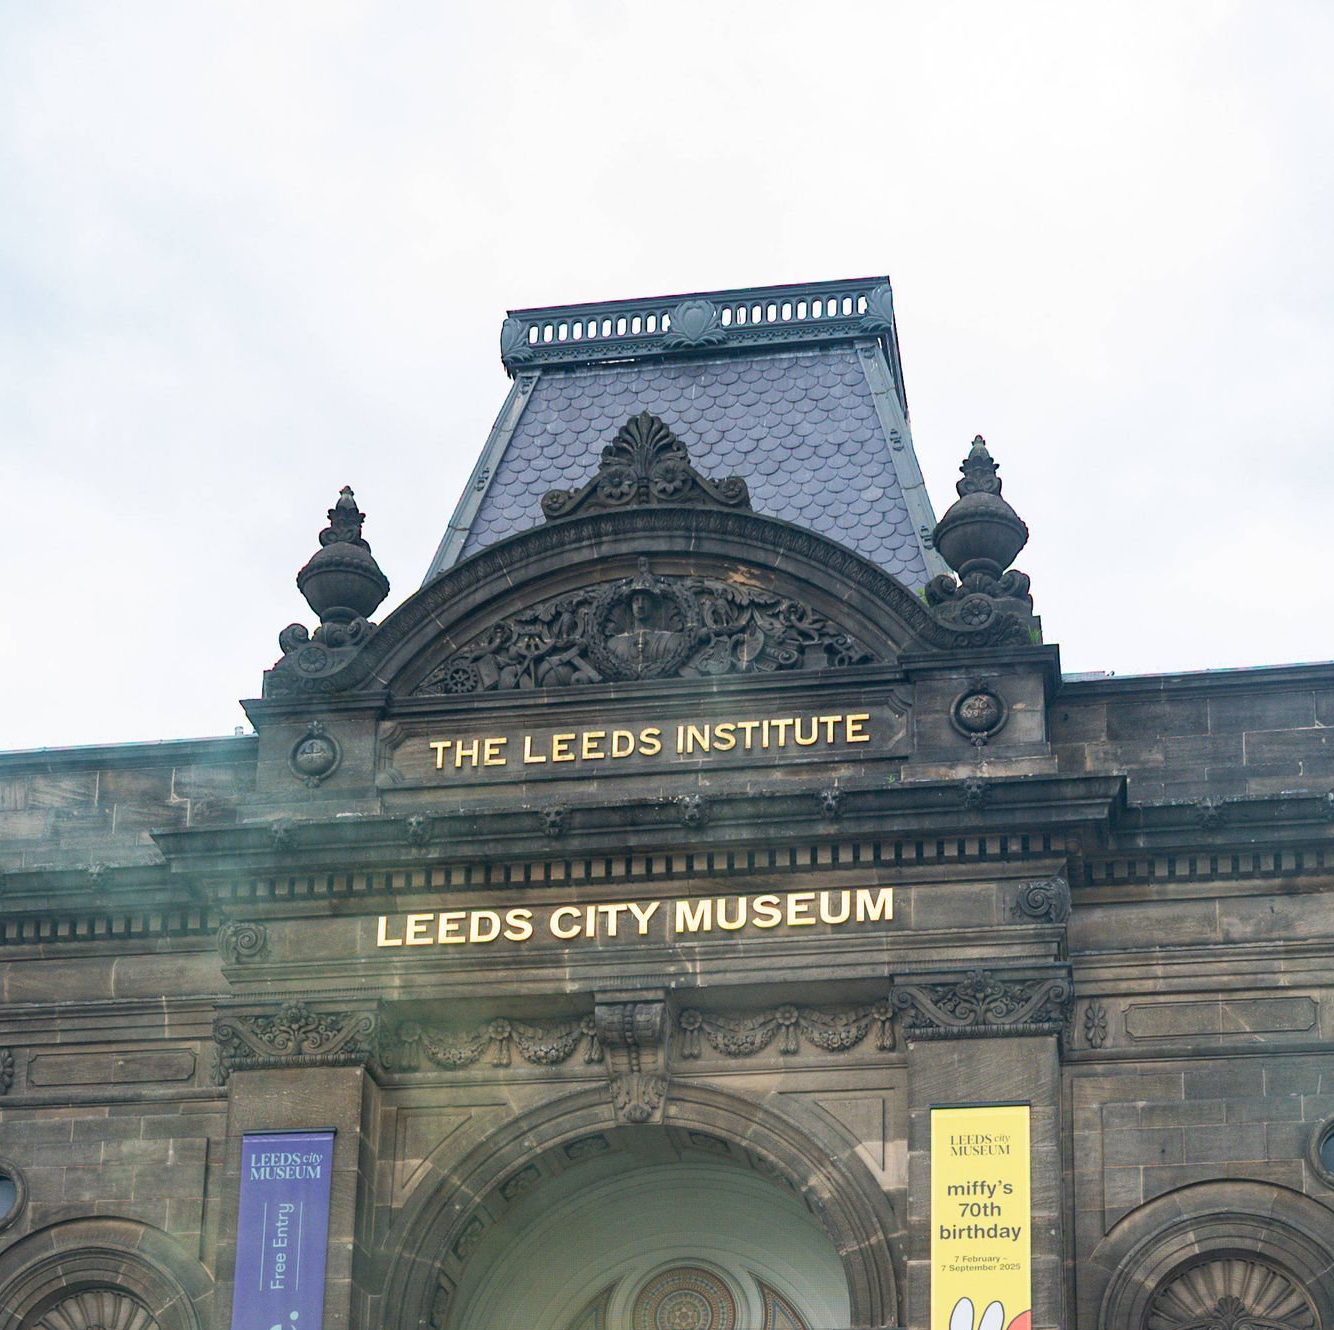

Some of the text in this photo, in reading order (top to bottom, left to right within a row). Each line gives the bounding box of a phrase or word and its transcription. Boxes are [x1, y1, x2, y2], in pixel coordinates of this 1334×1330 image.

[429, 713, 870, 769] THE LEEDS INSTITUTE
[377, 887, 895, 947] LEEDS CITY MUSEUM
[950, 1134, 1011, 1146] LEEDS city
[950, 1144, 1011, 1157] MUSEUM
[250, 1152, 323, 1167] LEEDS city
[250, 1165, 322, 1181] MUSEUM
[958, 1202, 1002, 1217] 70th
[939, 1224, 1022, 1242] birthday
[270, 1203, 295, 1290] Free Entry
[962, 1255, 1001, 1263] February
[949, 1264, 997, 1273] September
[999, 1263, 1021, 1271] 2025
